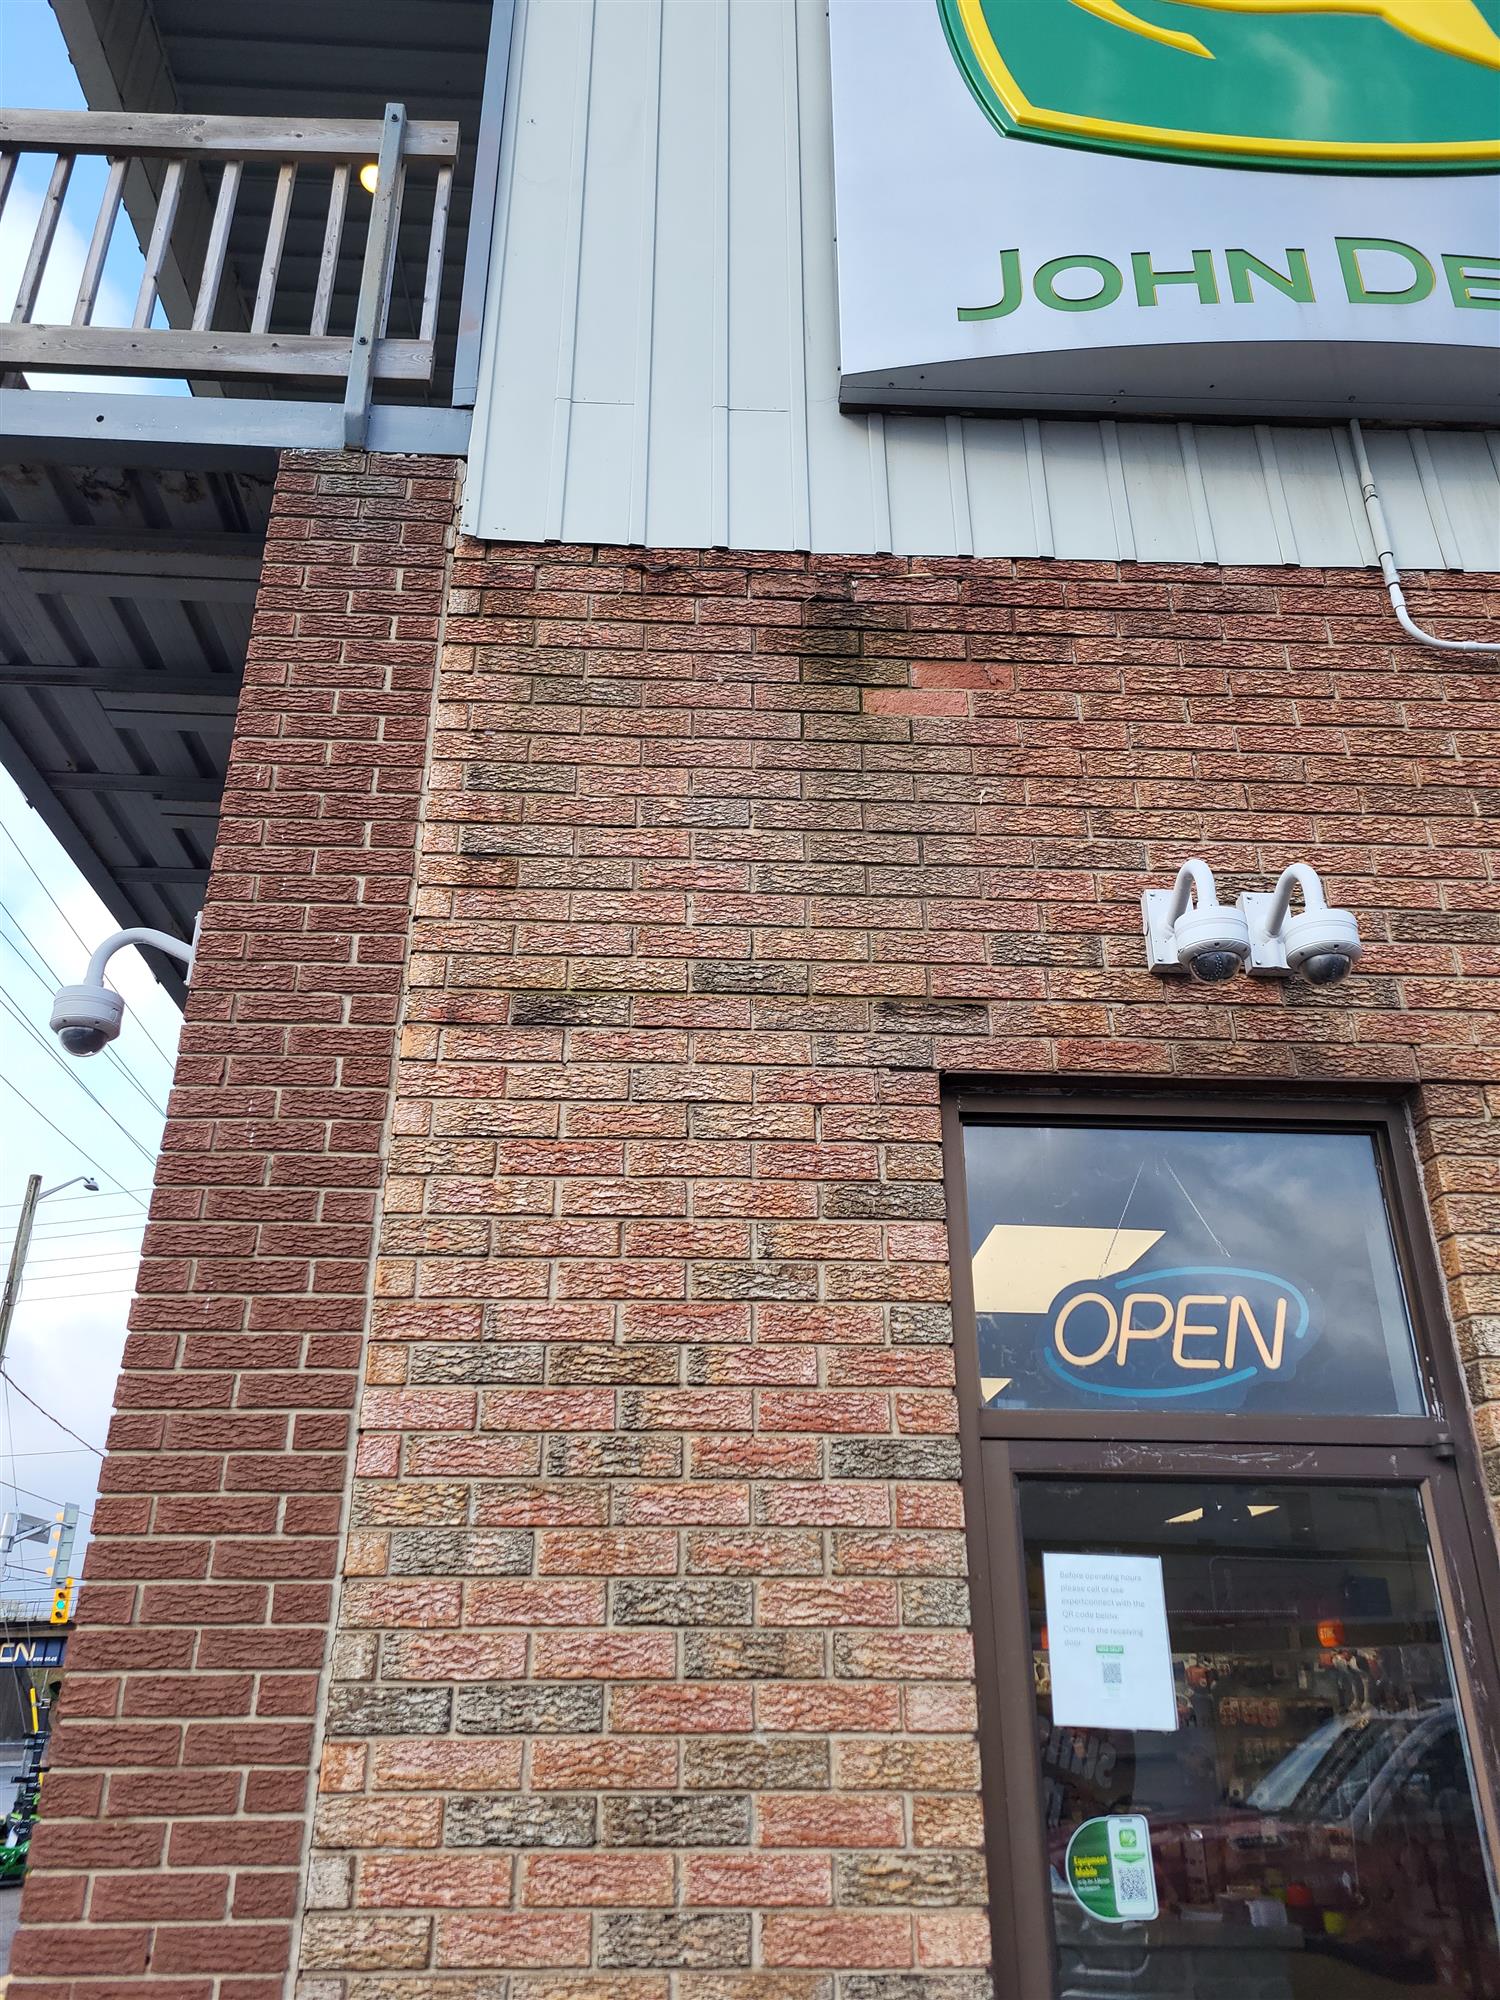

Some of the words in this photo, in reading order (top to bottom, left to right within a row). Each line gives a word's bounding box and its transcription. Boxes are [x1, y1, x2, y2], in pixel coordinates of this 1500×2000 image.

[957, 248, 1316, 322] JOHN
[1054, 1292, 1287, 1369] OPEN
[1059, 1571, 1083, 1580] Before
[1085, 1572, 1119, 1582] operating
[1120, 1573, 1142, 1582] hours
[1060, 1584, 1085, 1593] please
[1086, 1584, 1100, 1593] call
[1115, 1598, 1132, 1608] with
[1133, 1599, 1145, 1608] the
[1062, 1609, 1074, 1619] QR
[1075, 1610, 1094, 1619] code
[1063, 1624, 1086, 1633] Come
[1087, 1625, 1096, 1633] to
[1096, 1625, 1109, 1634] the
[1110, 1627, 1143, 1637] receiving
[0, 1642, 36, 1662] CN
